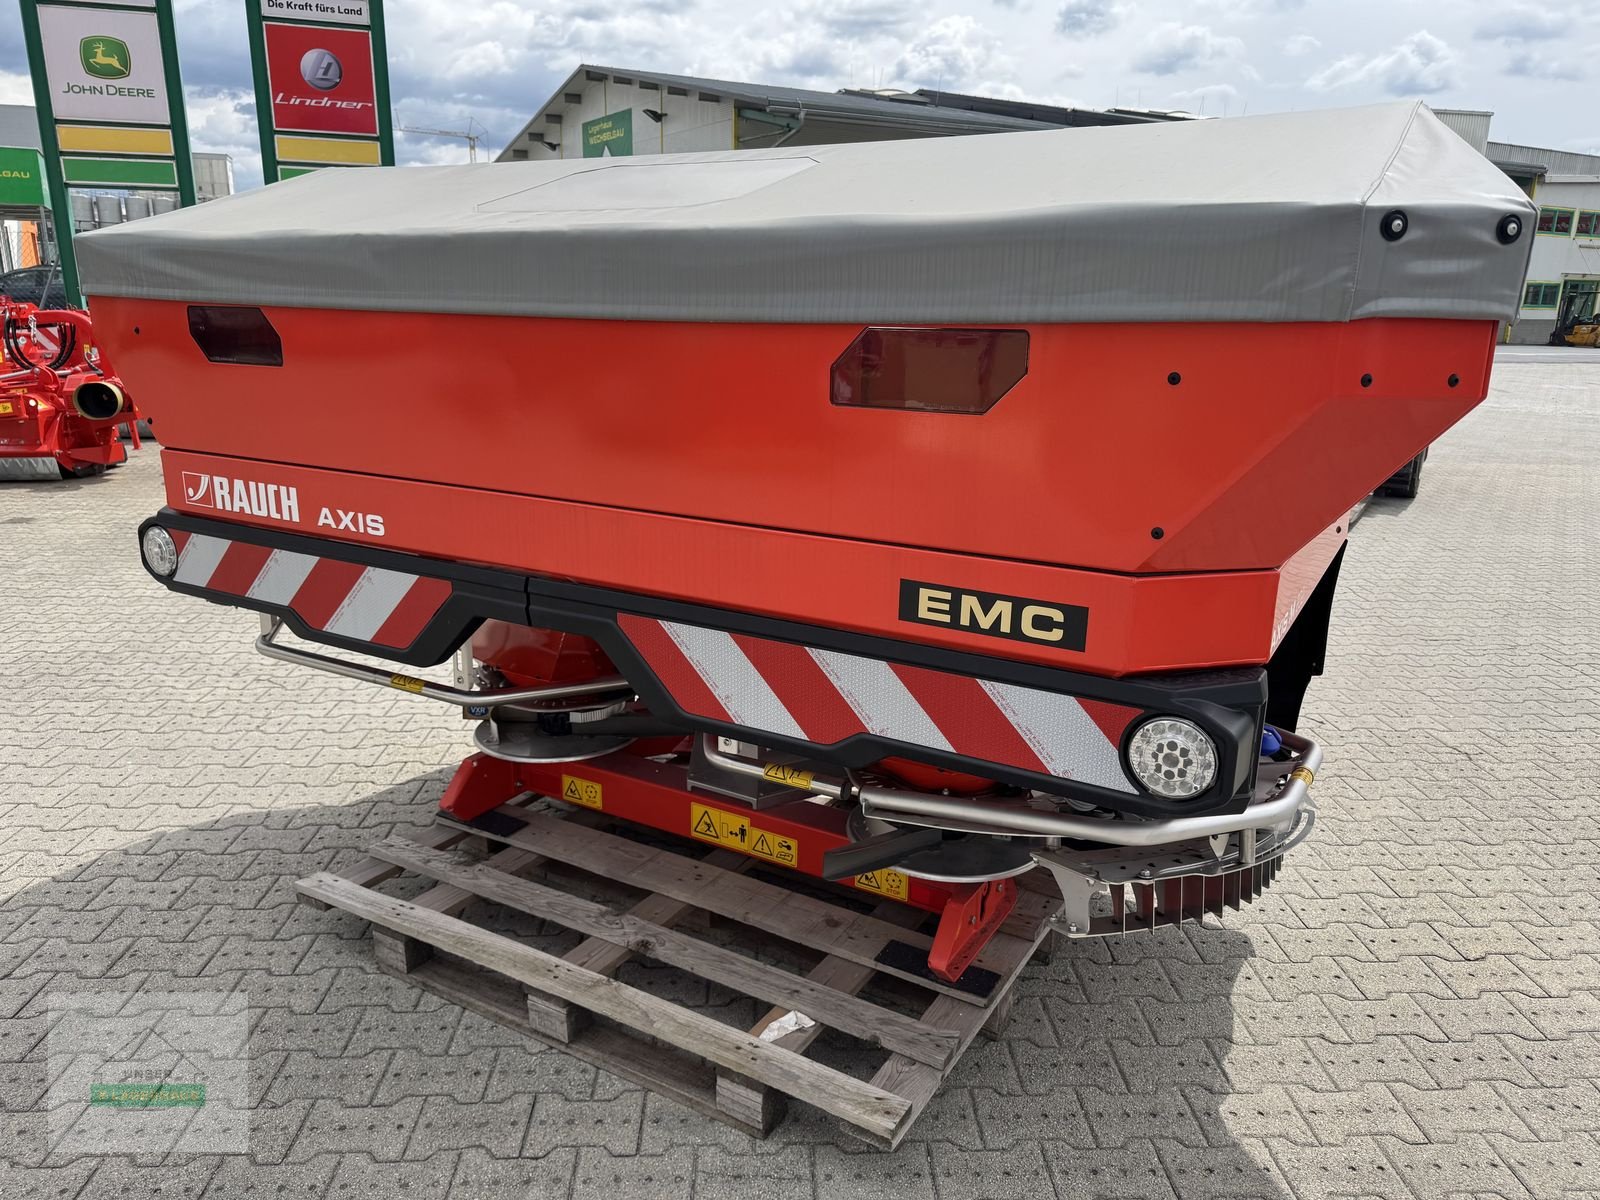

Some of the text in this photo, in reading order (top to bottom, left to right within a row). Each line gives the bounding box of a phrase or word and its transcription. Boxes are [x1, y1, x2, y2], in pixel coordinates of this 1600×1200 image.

[267, 0, 363, 16] Die Kraft fürs Land
[62, 81, 156, 98] JOHN DEERE
[275, 92, 373, 109] Lindner
[0, 169, 31, 179] GAU
[213, 476, 386, 537] RAUCH AXIS
[917, 587, 1065, 642] EMC
[470, 705, 486, 714] VXR
